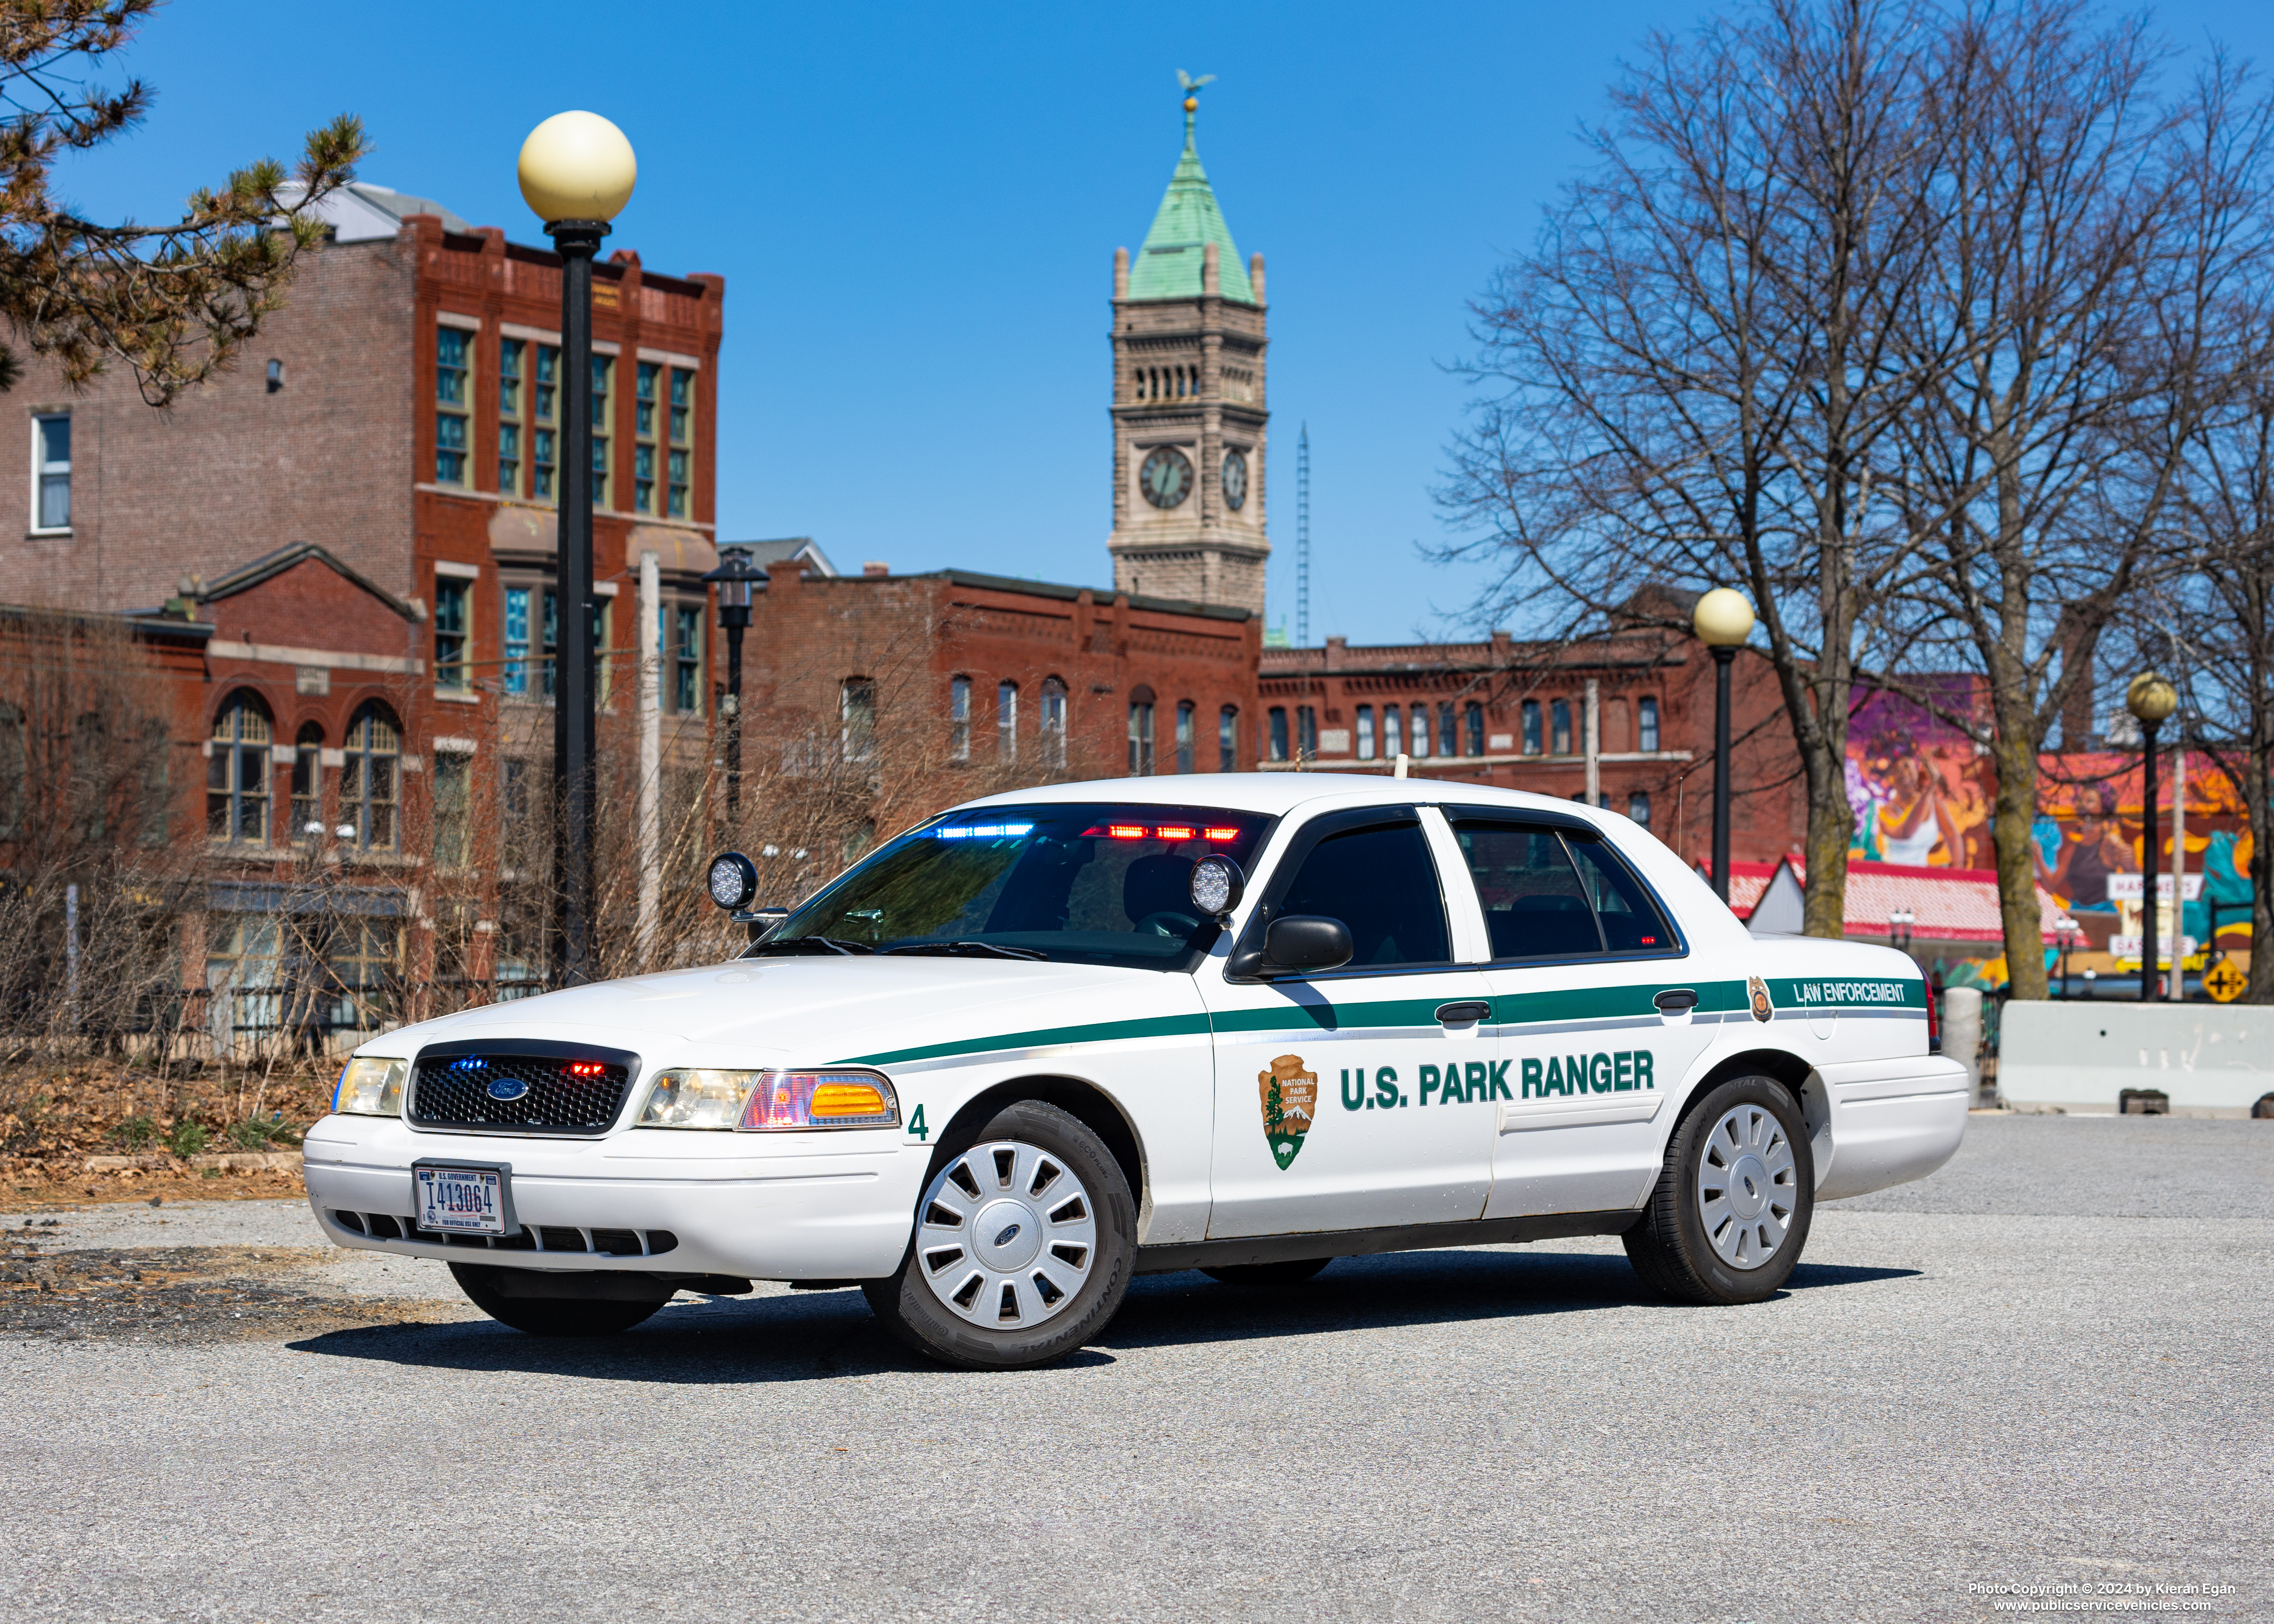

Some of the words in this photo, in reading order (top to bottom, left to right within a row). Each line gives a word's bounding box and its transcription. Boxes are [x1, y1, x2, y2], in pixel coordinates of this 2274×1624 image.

[1793, 984, 1821, 1002] LAW
[1823, 983, 1904, 1002] ENFORCEMENT
[495, 1082, 517, 1094] Ford
[1282, 1078, 1315, 1087] NATIONAL
[1341, 1066, 1408, 1111] U.S.
[1419, 1059, 1514, 1106] PARK
[1522, 1049, 1655, 1099] RANGER
[1285, 1095, 1312, 1104] SERVICE
[908, 1103, 929, 1141] 4
[426, 1182, 492, 1213] I413064
[1000, 1230, 1014, 1243] Ford
[1018, 1257, 1122, 1354] CONTINENTAL
